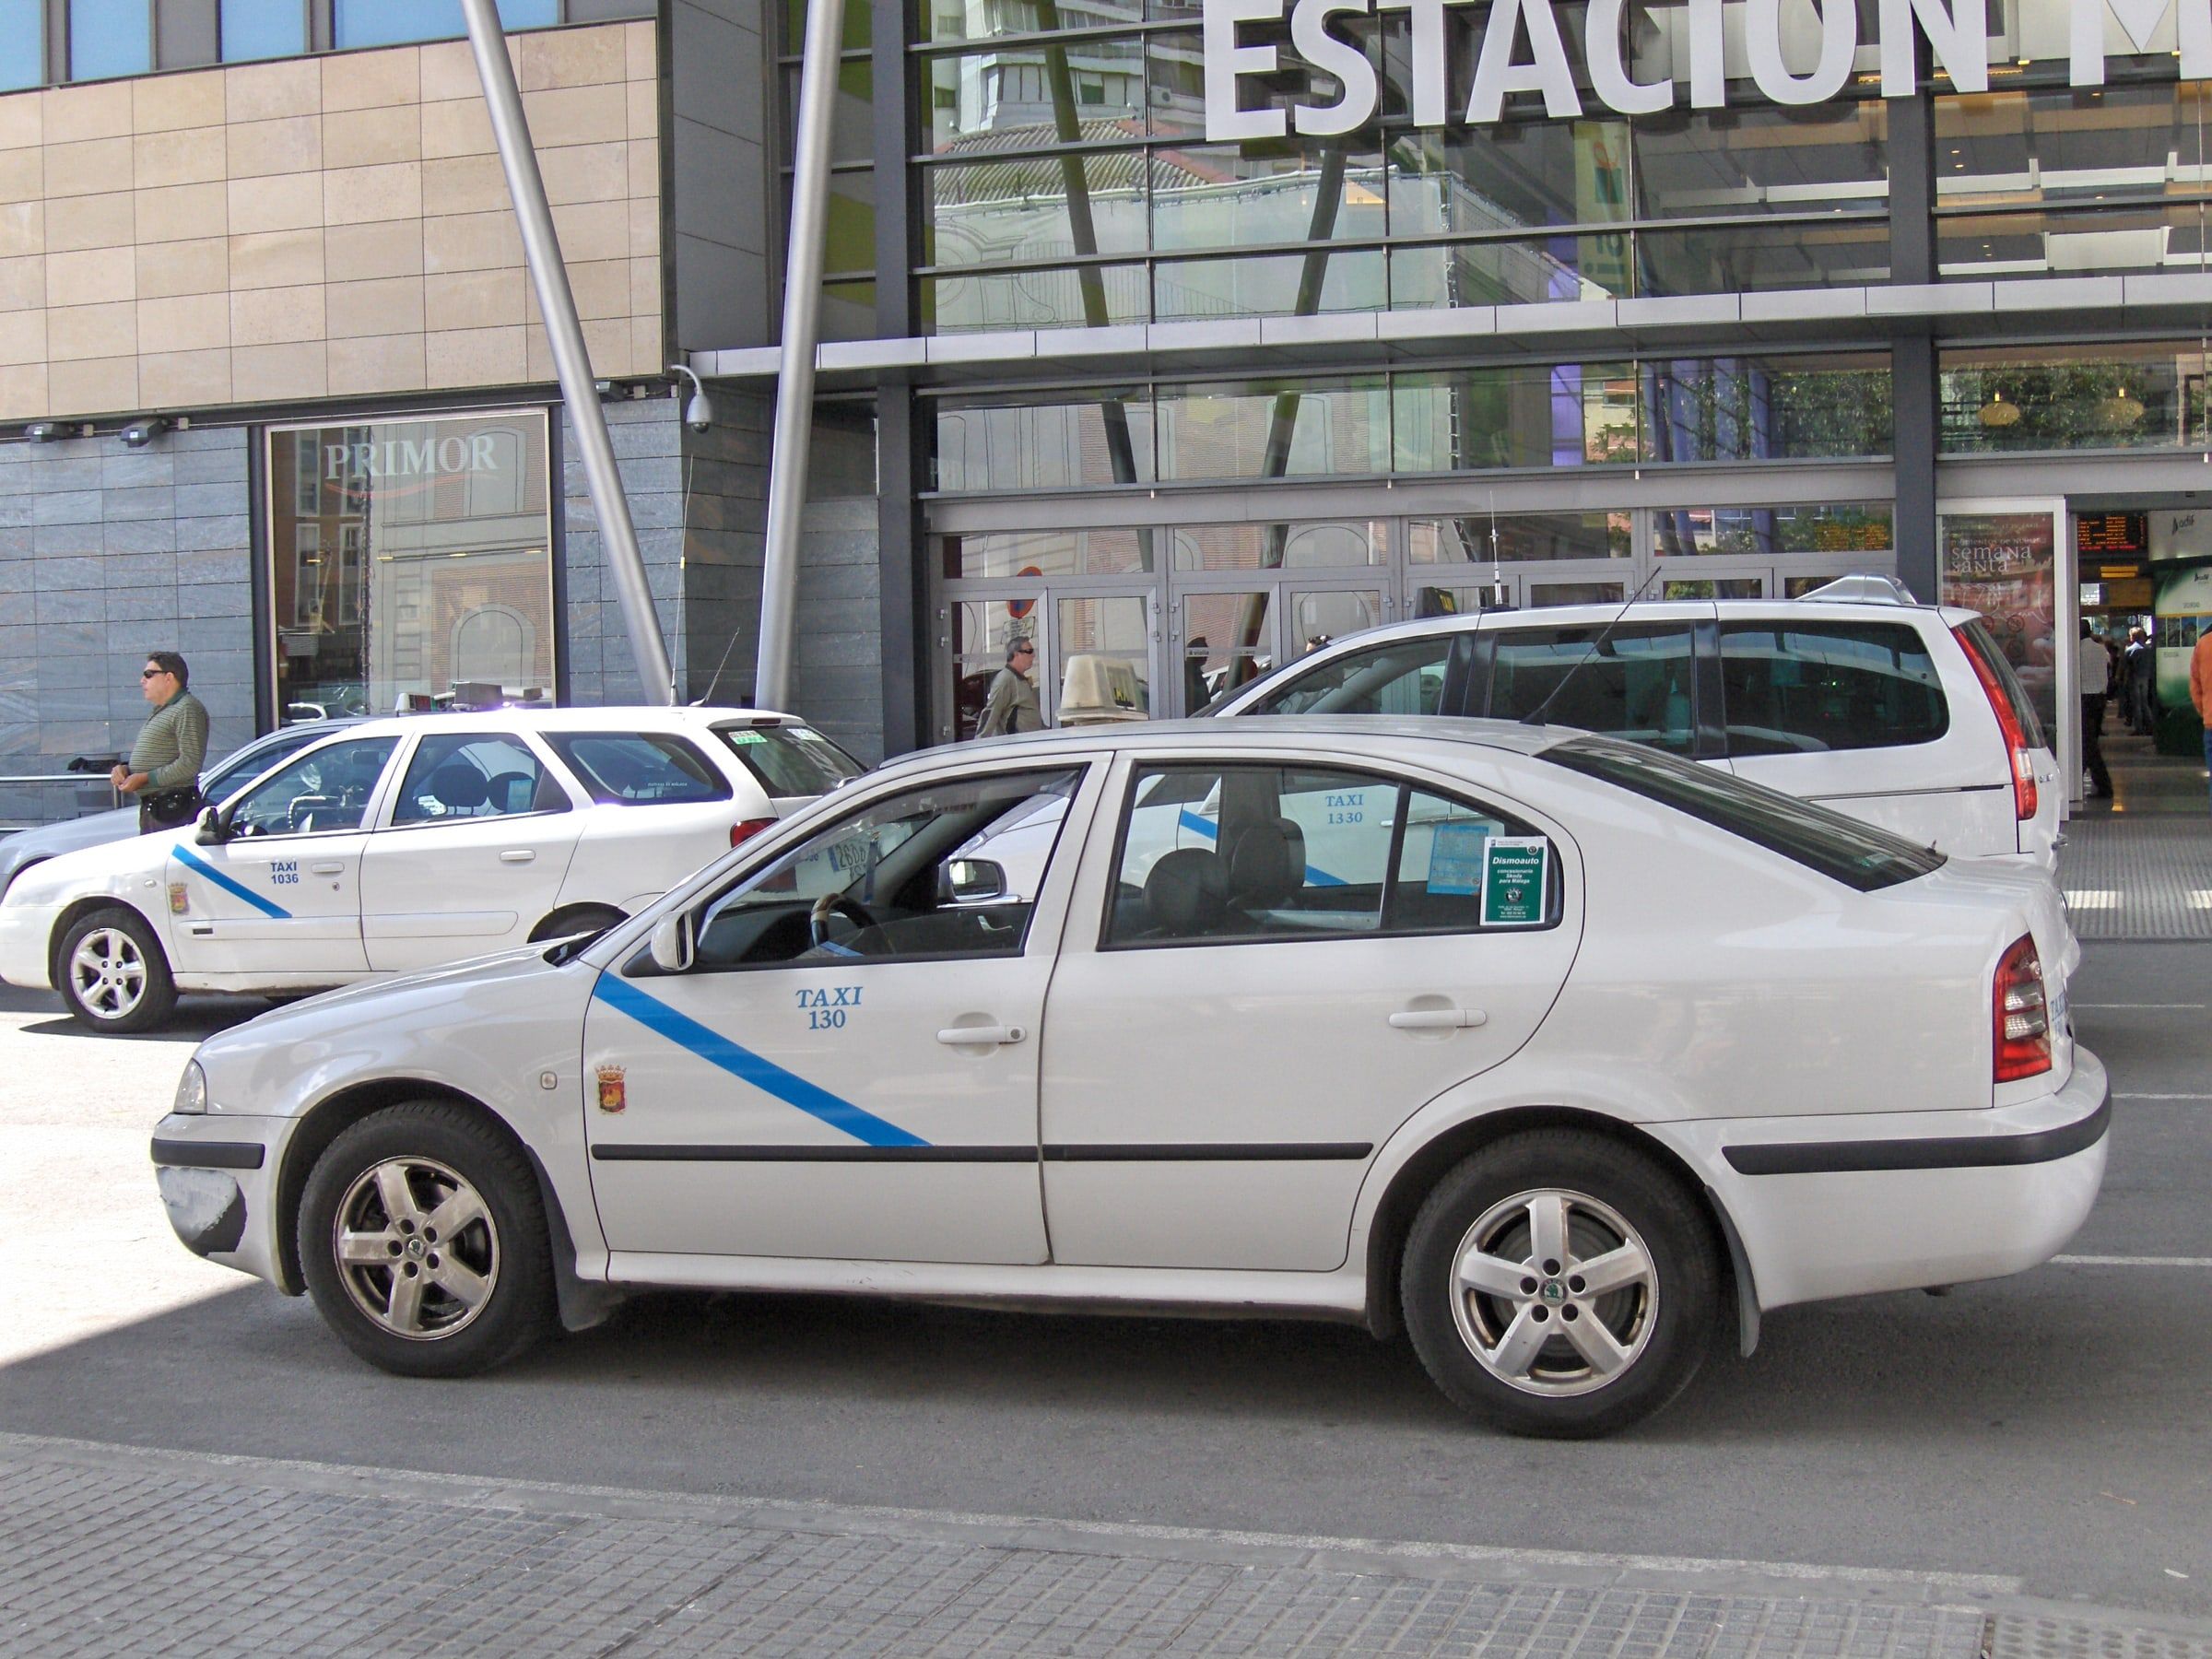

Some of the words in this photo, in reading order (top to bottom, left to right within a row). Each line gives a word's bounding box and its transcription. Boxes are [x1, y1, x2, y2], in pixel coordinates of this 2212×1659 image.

[324, 435, 500, 479] PRIMOR
[1324, 794, 1364, 806] TAXI
[1327, 811, 1363, 825] 1330
[270, 862, 297, 872] TAXI
[1492, 856, 1539, 865] Dismoauto
[271, 873, 299, 884] 1036
[795, 986, 864, 1007] TAXI
[808, 1009, 846, 1030] 130
